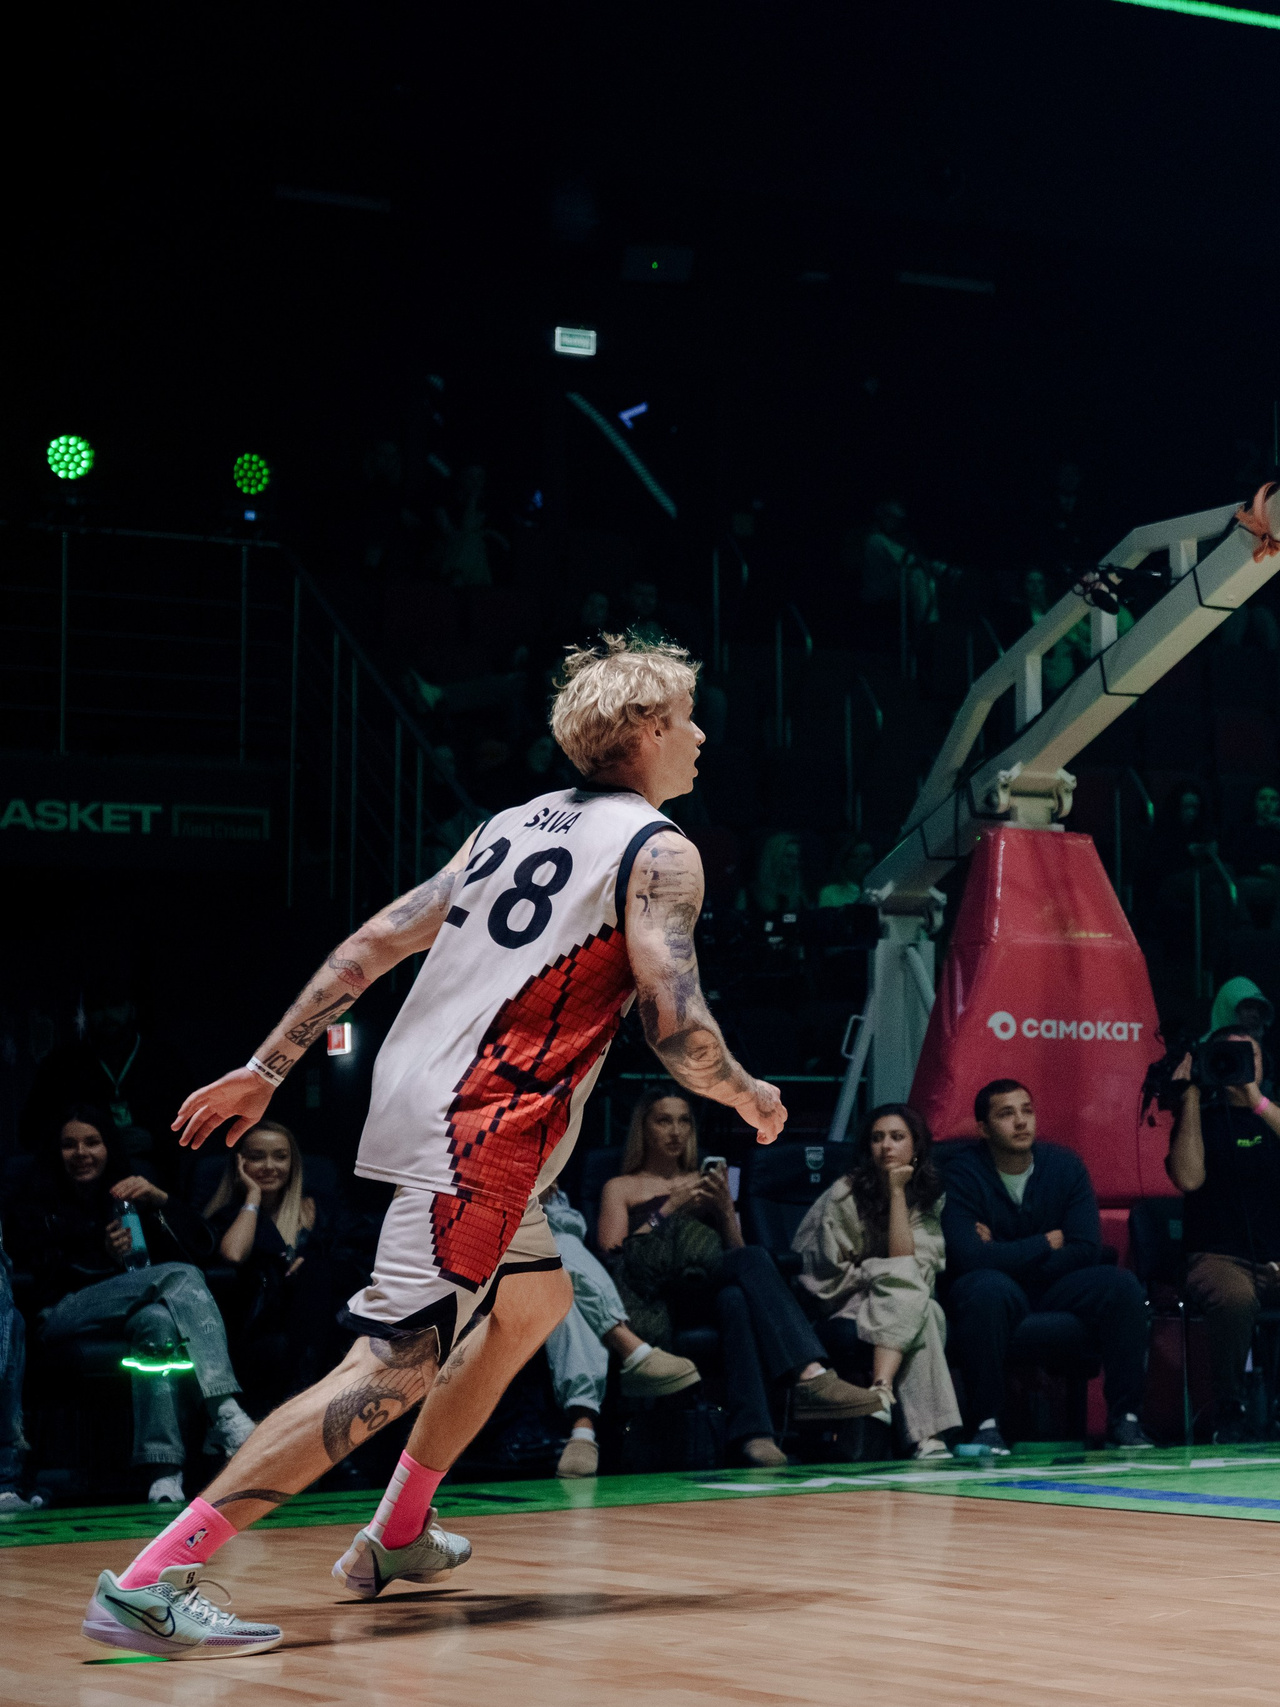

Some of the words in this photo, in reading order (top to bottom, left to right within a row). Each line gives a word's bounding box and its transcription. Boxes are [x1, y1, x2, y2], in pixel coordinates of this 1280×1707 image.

[0, 798, 162, 834] ASKET
[524, 807, 582, 835] SAVA
[445, 837, 573, 949] 28
